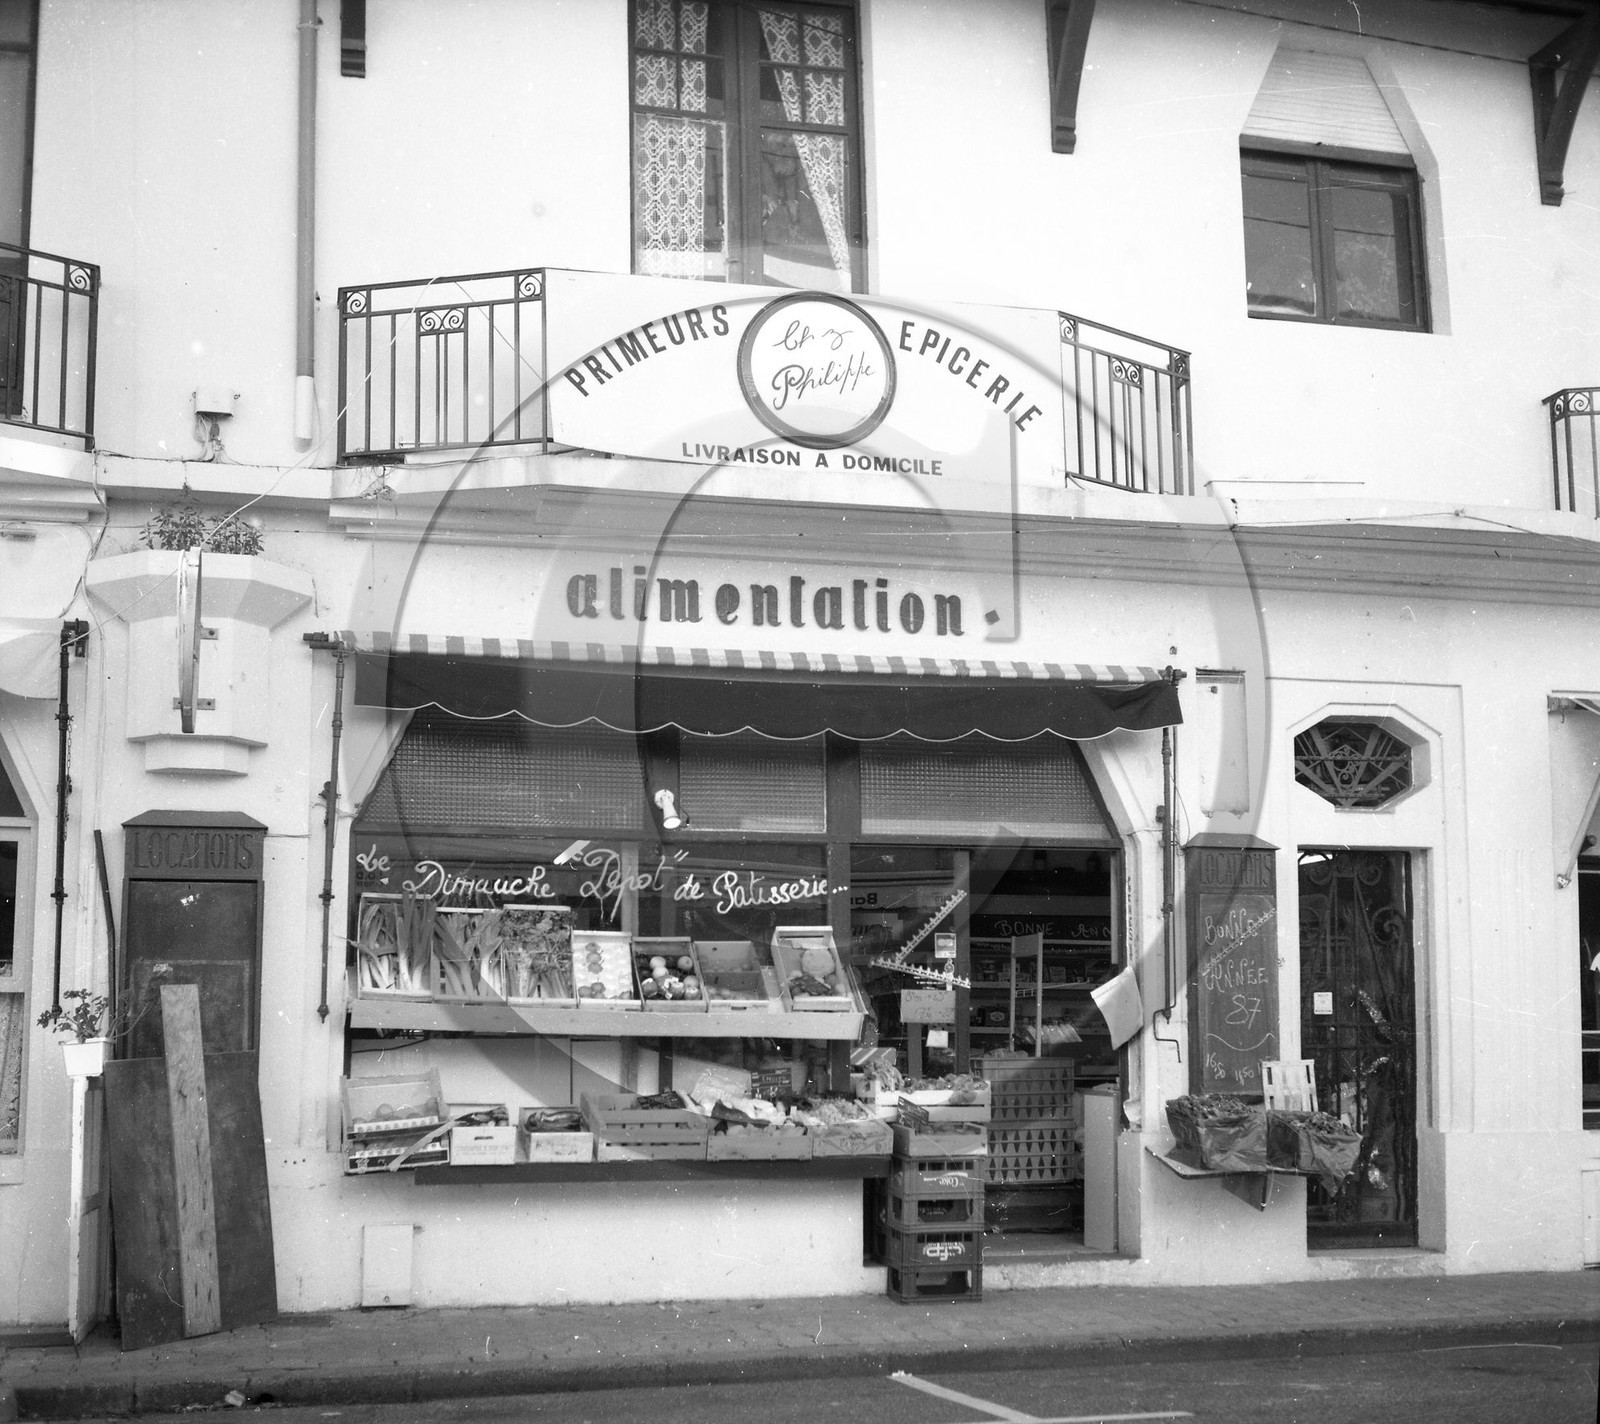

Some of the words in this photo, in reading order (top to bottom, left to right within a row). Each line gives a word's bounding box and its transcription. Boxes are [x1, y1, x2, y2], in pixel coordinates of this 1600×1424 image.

[564, 304, 730, 397] PRIMEURS
[771, 351, 878, 411] Philippe
[898, 320, 1043, 432] EPICERIE
[682, 442, 800, 466] LIVRAISON
[815, 452, 829, 468] A
[843, 454, 943, 475] DOMICILE
[135, 832, 254, 870] LOCATIONS
[1200, 853, 1273, 886] LOCATIONS
[402, 860, 556, 899] Dimanche
[674, 874, 704, 900] de
[1225, 994, 1261, 1030] 87
